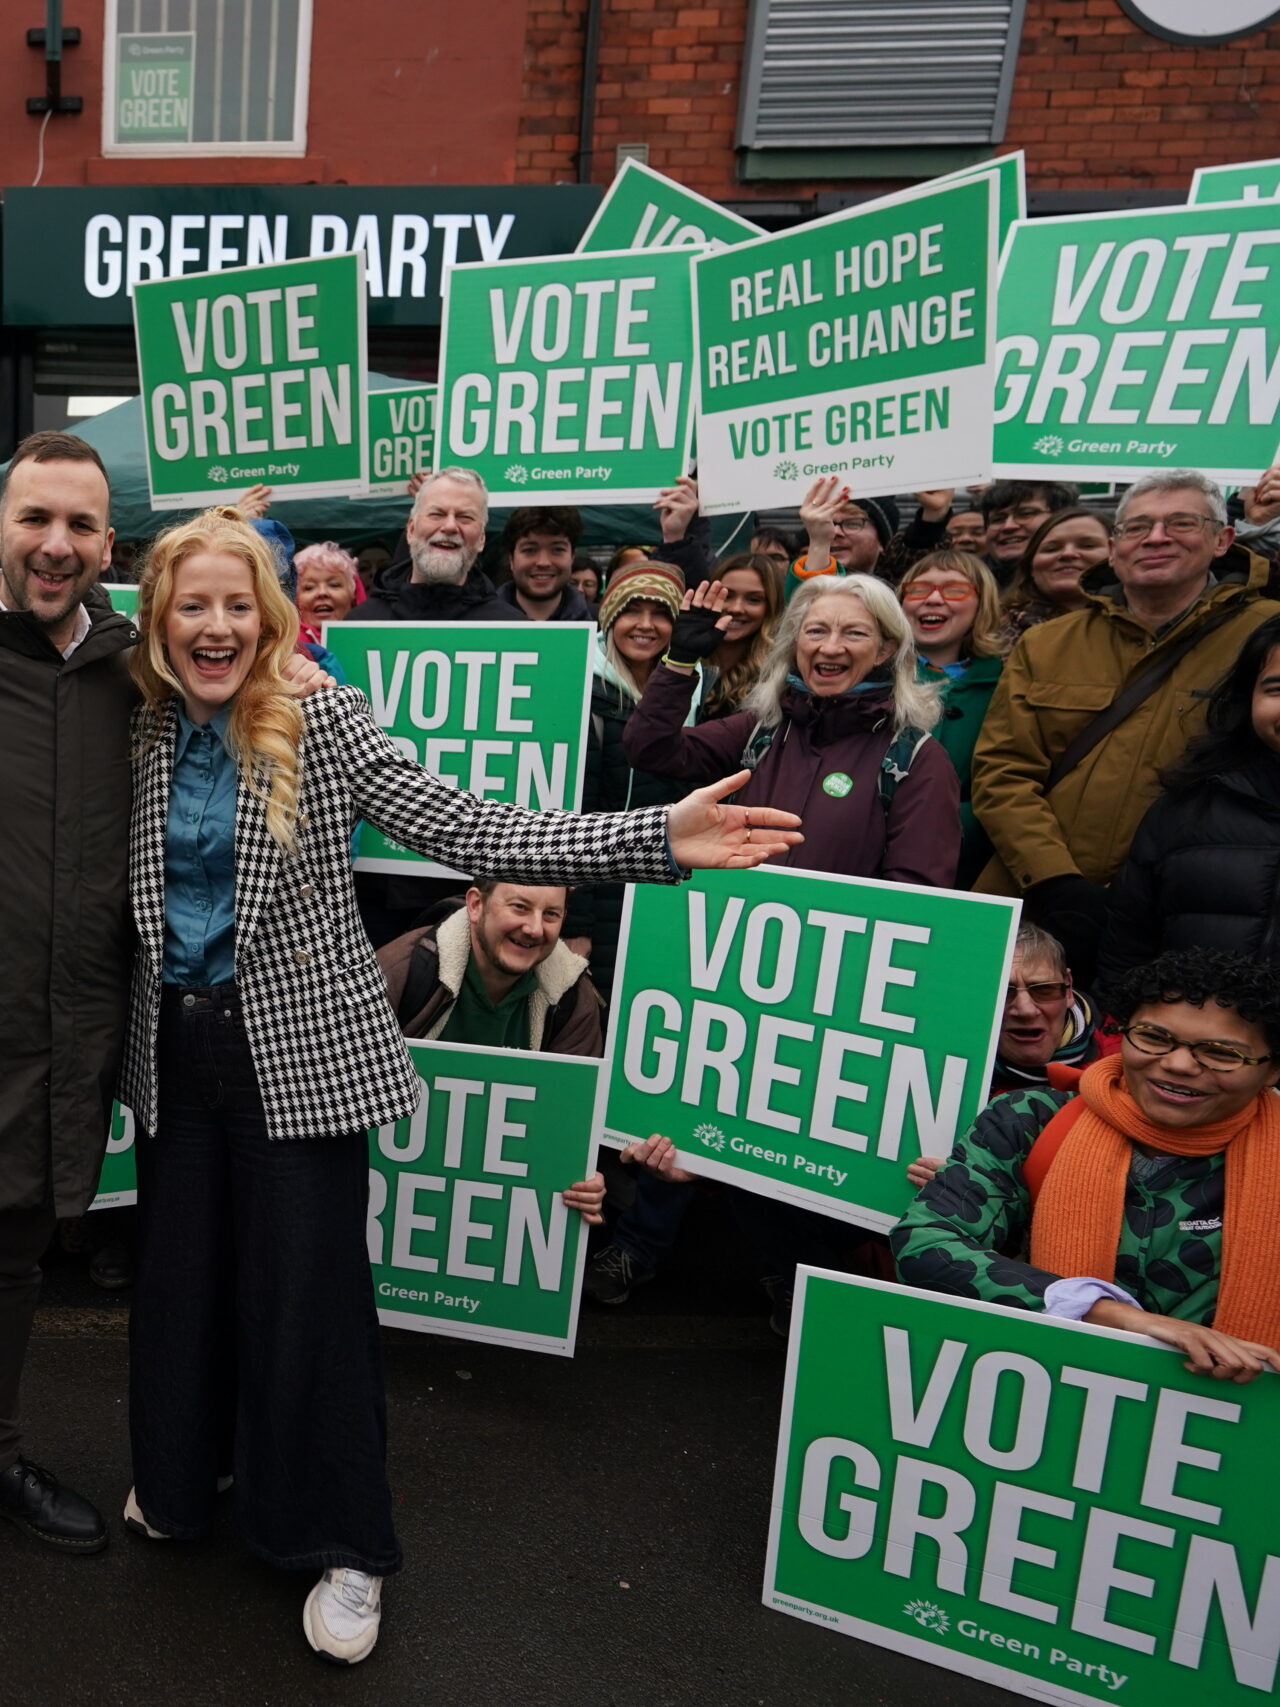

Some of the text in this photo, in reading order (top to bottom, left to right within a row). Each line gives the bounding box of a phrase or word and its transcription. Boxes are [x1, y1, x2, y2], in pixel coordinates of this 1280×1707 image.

[120, 98, 188, 128] GREEN
[131, 68, 180, 97] VOTE
[730, 223, 944, 323] REAL HOPE
[1051, 229, 1280, 327] VOTE
[171, 283, 320, 374] VOTE
[489, 277, 656, 364] VOTE
[707, 287, 976, 389] REAL CHANGE
[151, 364, 352, 462] GREEN
[388, 394, 437, 434] VOT
[449, 363, 683, 458] GREEN
[994, 327, 1280, 425] GREEN
[373, 434, 433, 478] GRE
[728, 386, 950, 461] VOTE GREEN
[1067, 439, 1178, 457] Green Party
[230, 463, 300, 479] Green Party
[530, 466, 612, 481] Green Party
[802, 455, 895, 477] Green Party
[366, 650, 540, 734] VOTE
[688, 890, 932, 1033] VOTE
[623, 988, 968, 1163] GREEN
[377, 1075, 537, 1177] OTE
[730, 1136, 849, 1187] Green Party
[378, 1282, 480, 1313] Green Party
[882, 1325, 1242, 1526] VOTE
[797, 1436, 1280, 1694] GREEN
[772, 1597, 840, 1624] greenparty.org.uk
[957, 1620, 1129, 1690] Green Party
